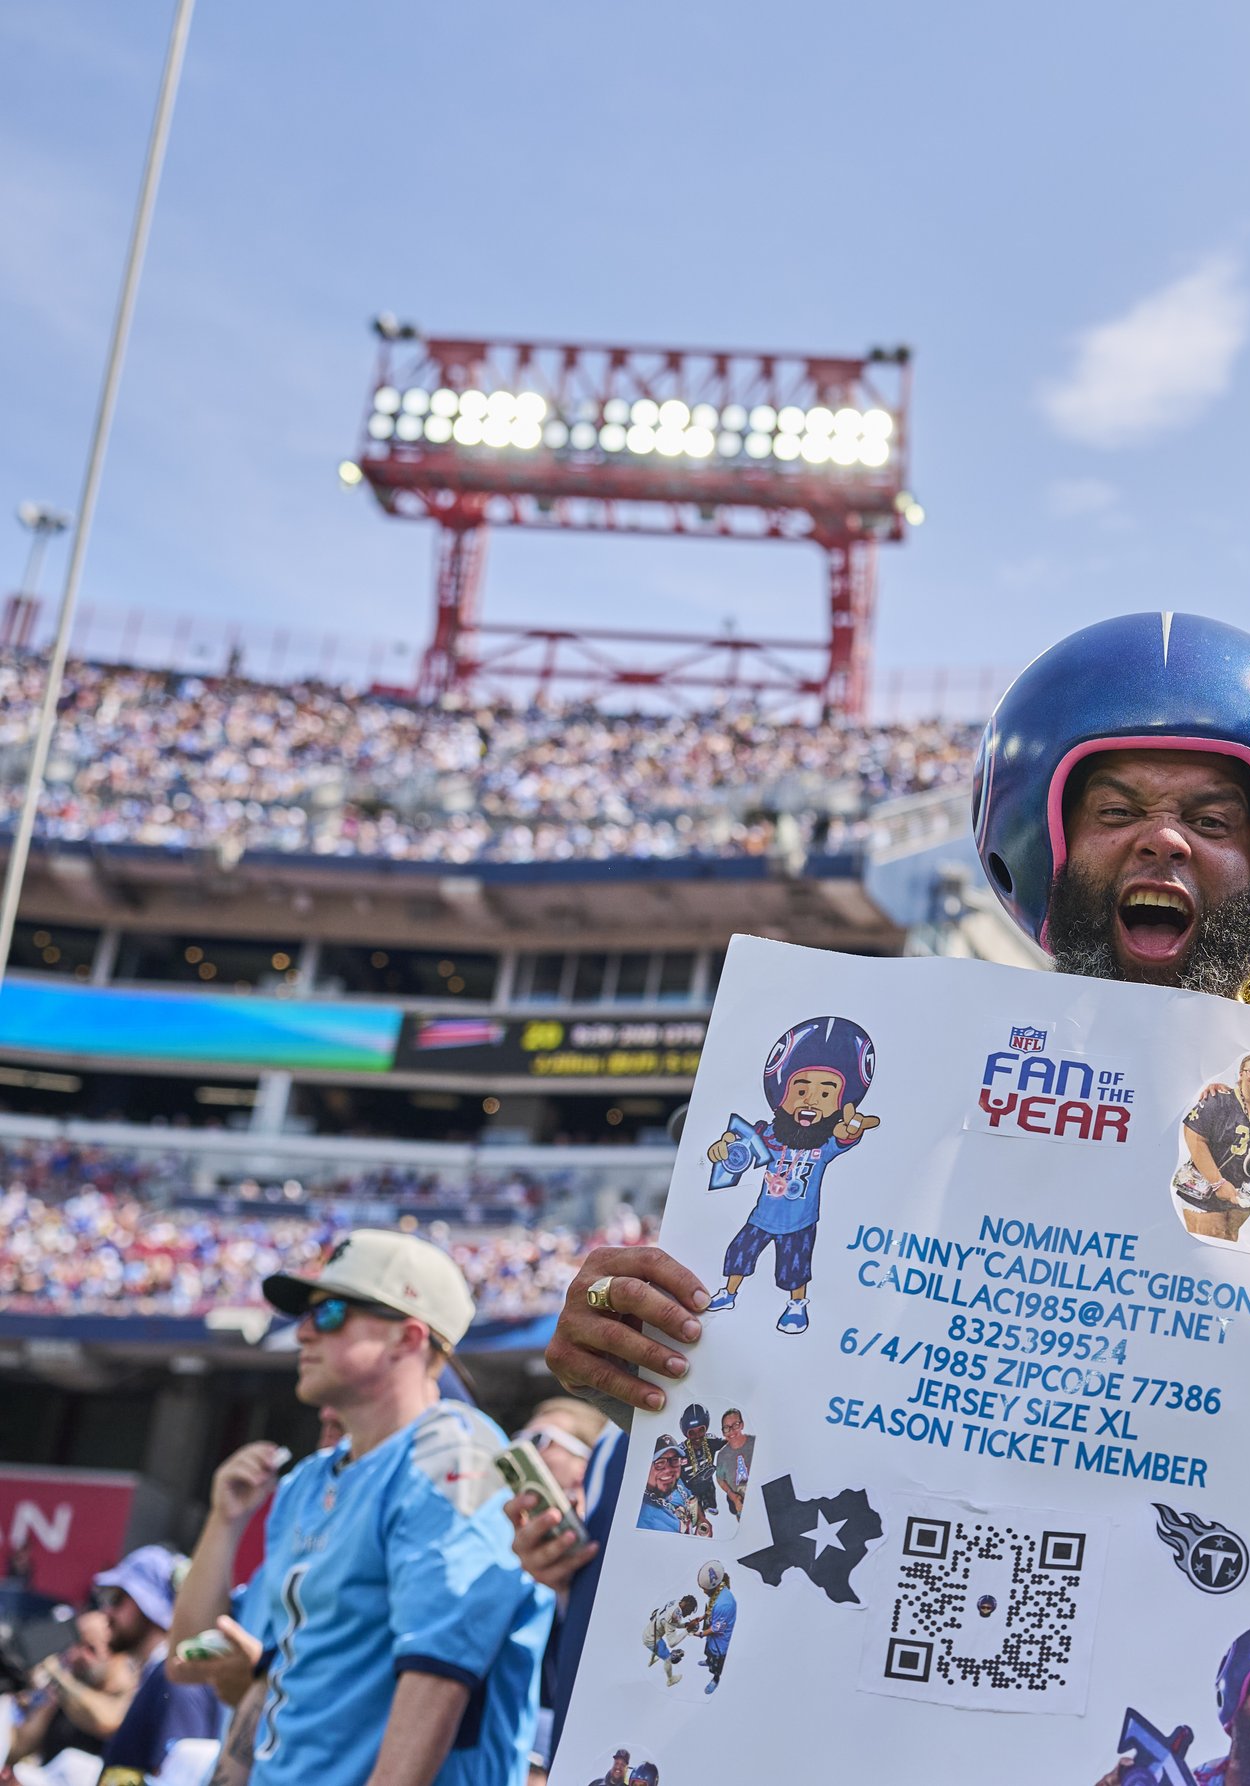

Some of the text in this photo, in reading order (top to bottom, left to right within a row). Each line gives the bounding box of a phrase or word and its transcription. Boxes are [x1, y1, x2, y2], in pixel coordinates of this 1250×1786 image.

[1012, 1036, 1042, 1051] NFL
[983, 1052, 1124, 1099] FAN OF
[1097, 1087, 1134, 1103] THE
[979, 1088, 1130, 1143] YEAR
[979, 1215, 1138, 1262] NOMINATE
[858, 1260, 1234, 1344] CADILLAC1985@ATT.NET
[948, 1315, 1127, 1365] 8325399524
[840, 1327, 1222, 1415] 6/4/1985 ZIPCODE 77386
[907, 1378, 1138, 1440] JERSEY SIZE XL
[825, 1397, 1208, 1487] SEASON TICKET MEMBER
[0, 1500, 73, 1552] N
